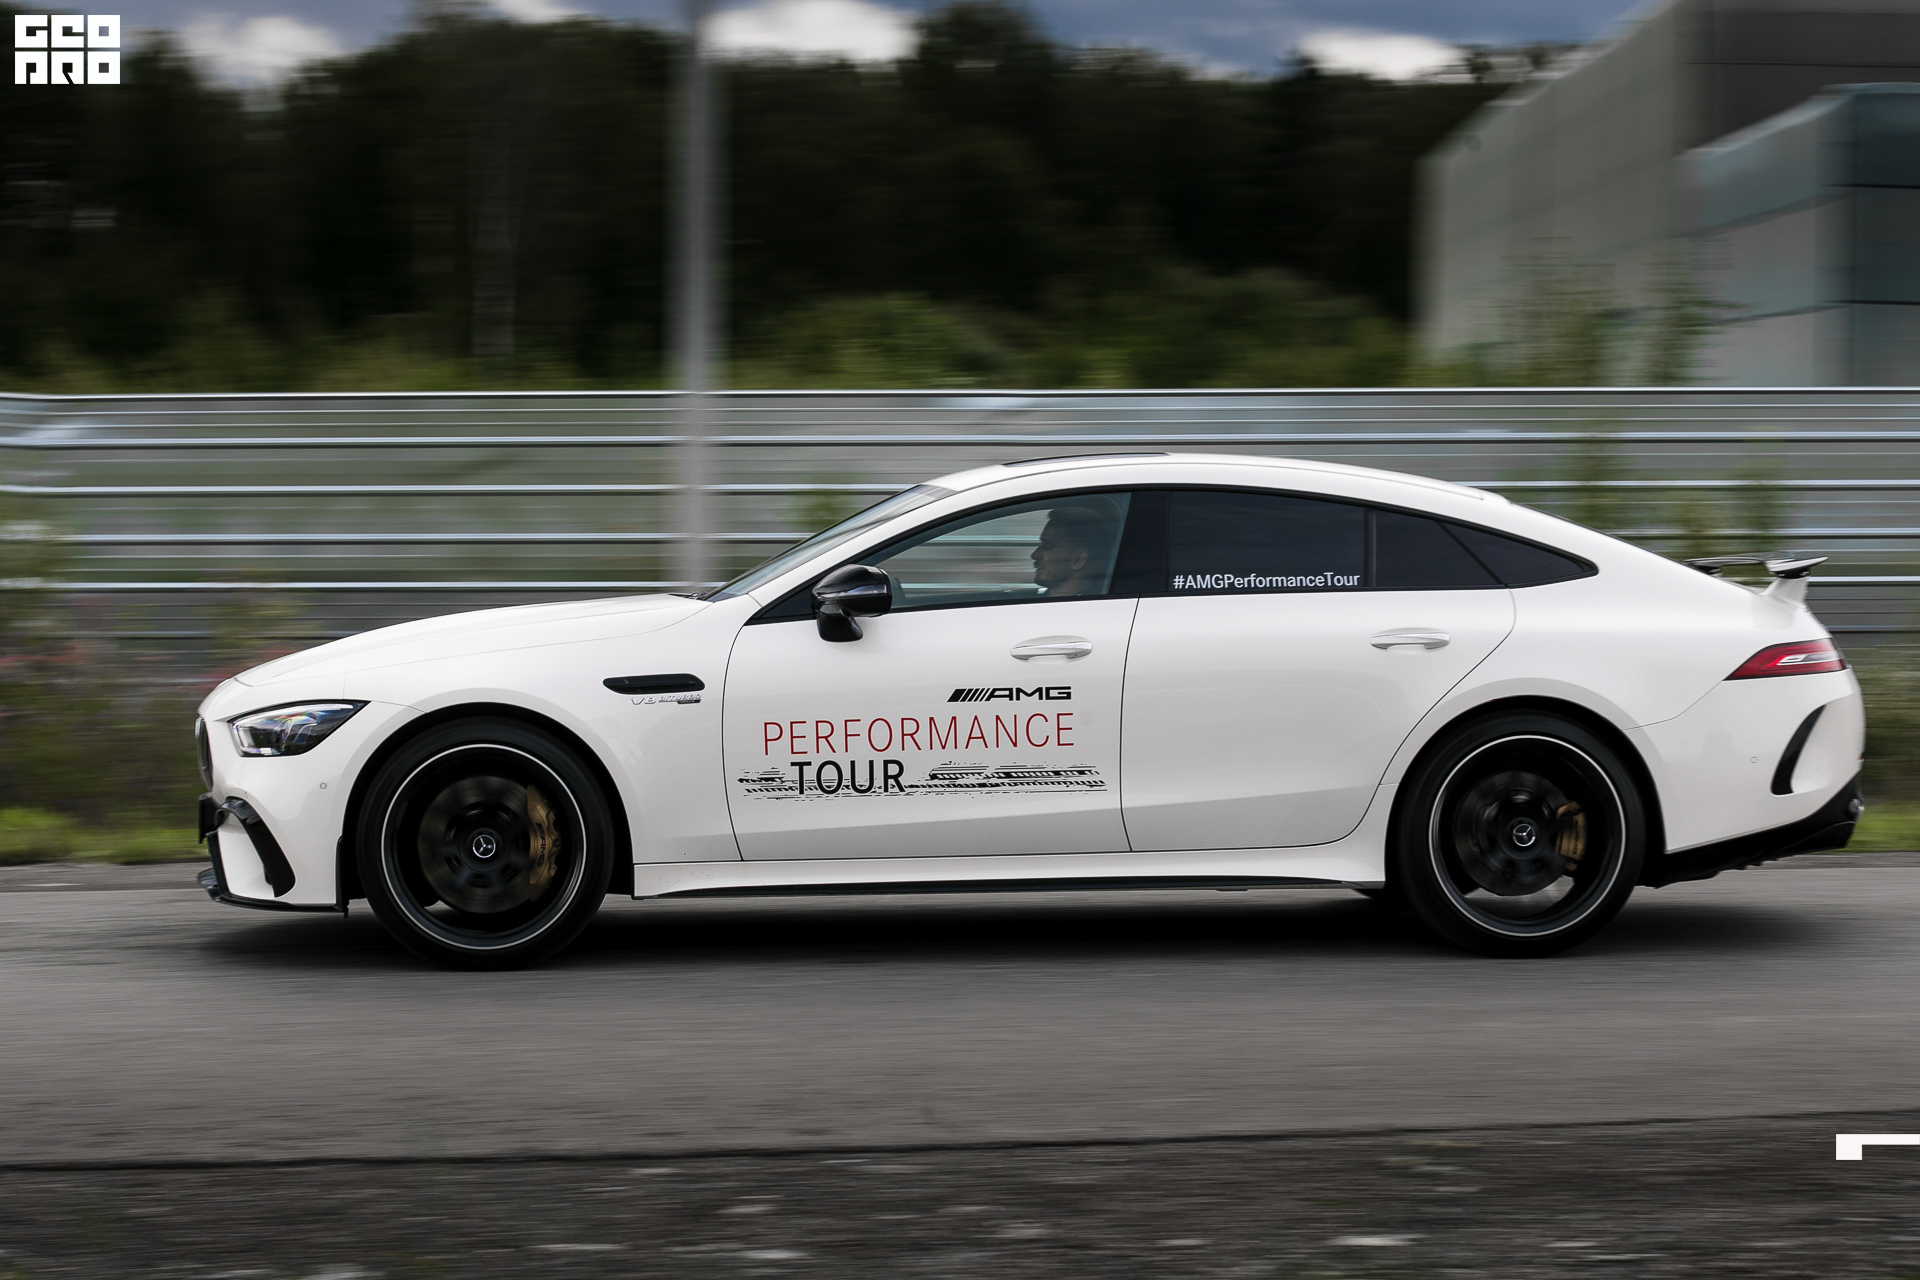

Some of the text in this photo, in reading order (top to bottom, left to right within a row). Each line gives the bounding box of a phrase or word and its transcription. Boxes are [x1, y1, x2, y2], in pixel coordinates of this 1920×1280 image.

[1173, 572, 1360, 589] #AMGPerformanceTour
[631, 697, 657, 705] V8
[984, 686, 1072, 702] AMG
[763, 712, 1075, 756] PERFORMANCE
[790, 759, 907, 795] TOUR
